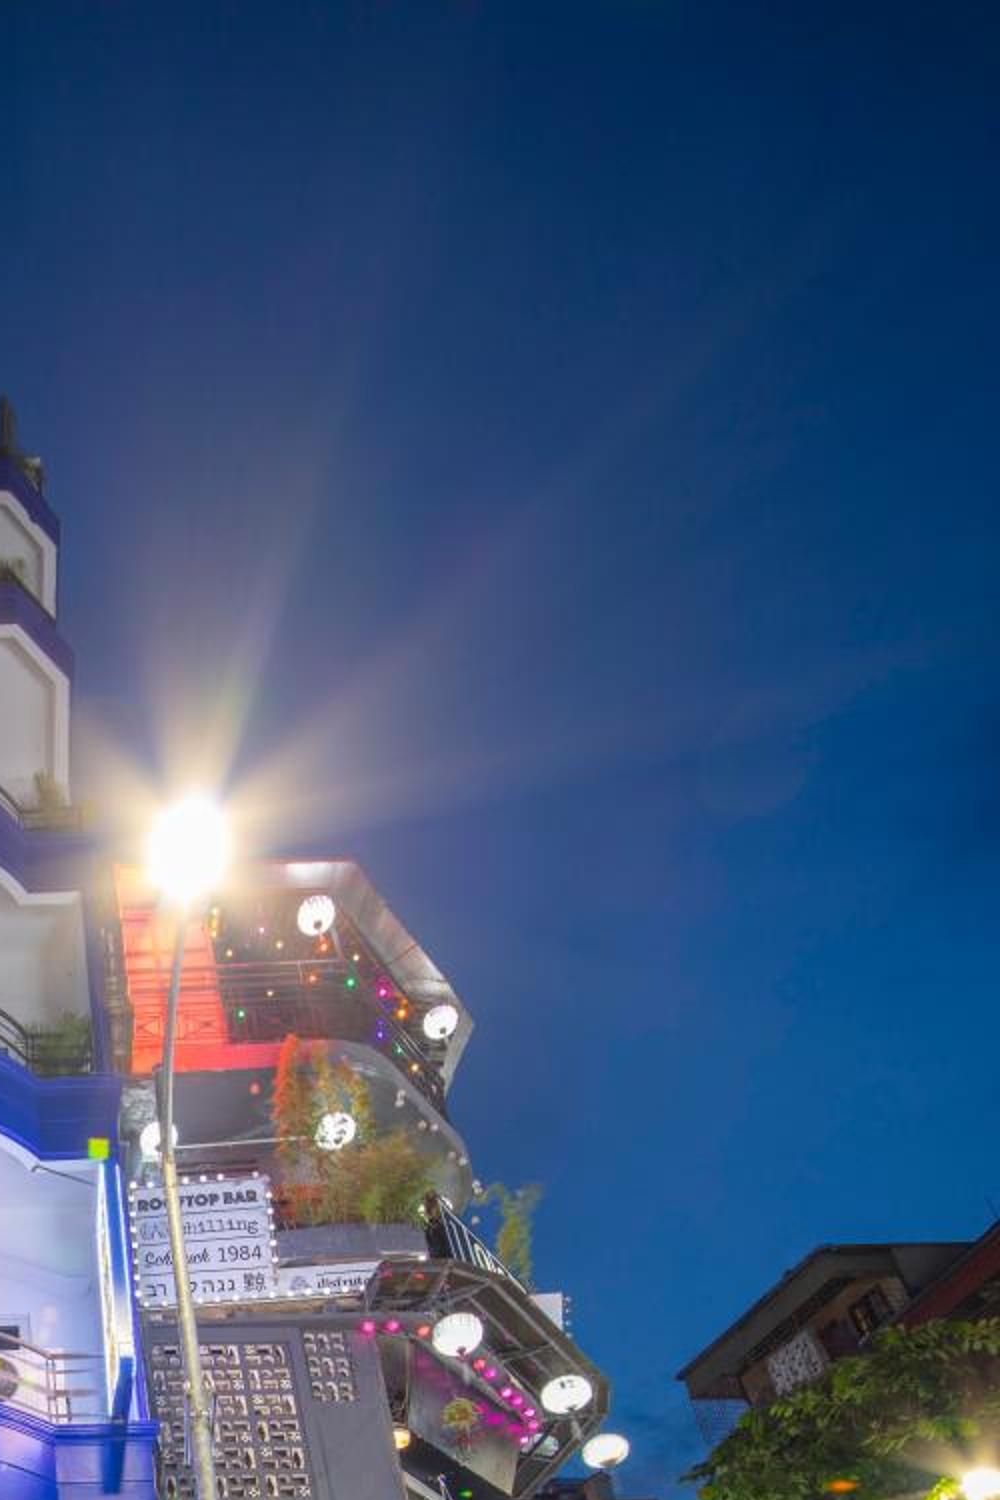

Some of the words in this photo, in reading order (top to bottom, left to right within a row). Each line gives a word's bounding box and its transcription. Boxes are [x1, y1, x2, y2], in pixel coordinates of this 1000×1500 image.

[137, 1193, 220, 1212] ROTOP
[222, 1189, 258, 1205] BAR
[218, 1246, 262, 1263] 1984
